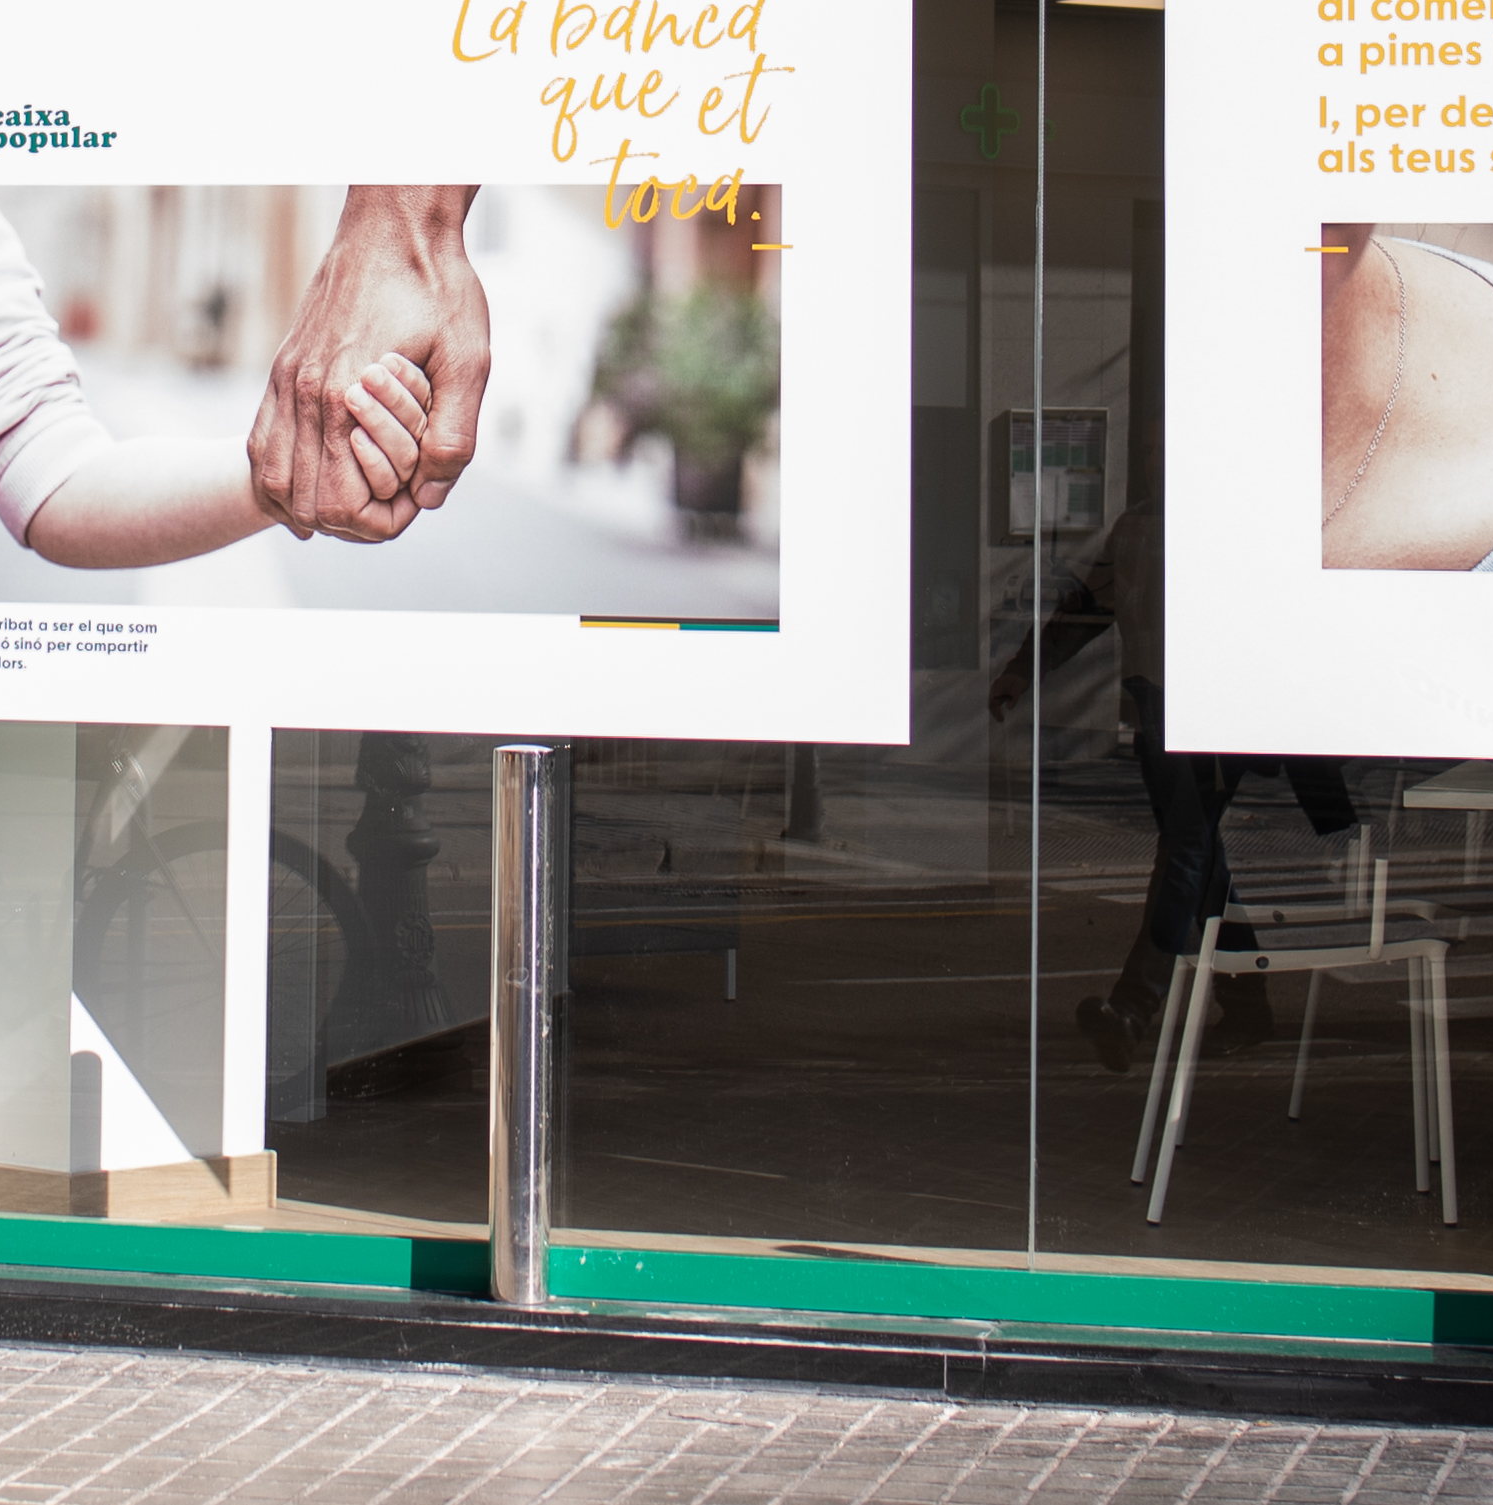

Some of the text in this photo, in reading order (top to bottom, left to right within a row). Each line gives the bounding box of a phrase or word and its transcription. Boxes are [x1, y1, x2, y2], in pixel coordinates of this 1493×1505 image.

[1318, 42, 1344, 67] a
[1359, 32, 1482, 74] pimes
[540, 52, 796, 163] que et
[1355, 102, 1426, 136] per
[1317, 140, 1375, 173] als
[1389, 143, 1476, 173] teus
[589, 139, 762, 230] toca.
[38, 621, 48, 632] a
[52, 621, 74, 632] ser
[78, 619, 92, 633] el
[96, 622, 124, 635] que
[128, 623, 158, 634] som
[14, 637, 43, 651] sinó
[47, 641, 72, 654] per
[76, 639, 149, 655] compartir
